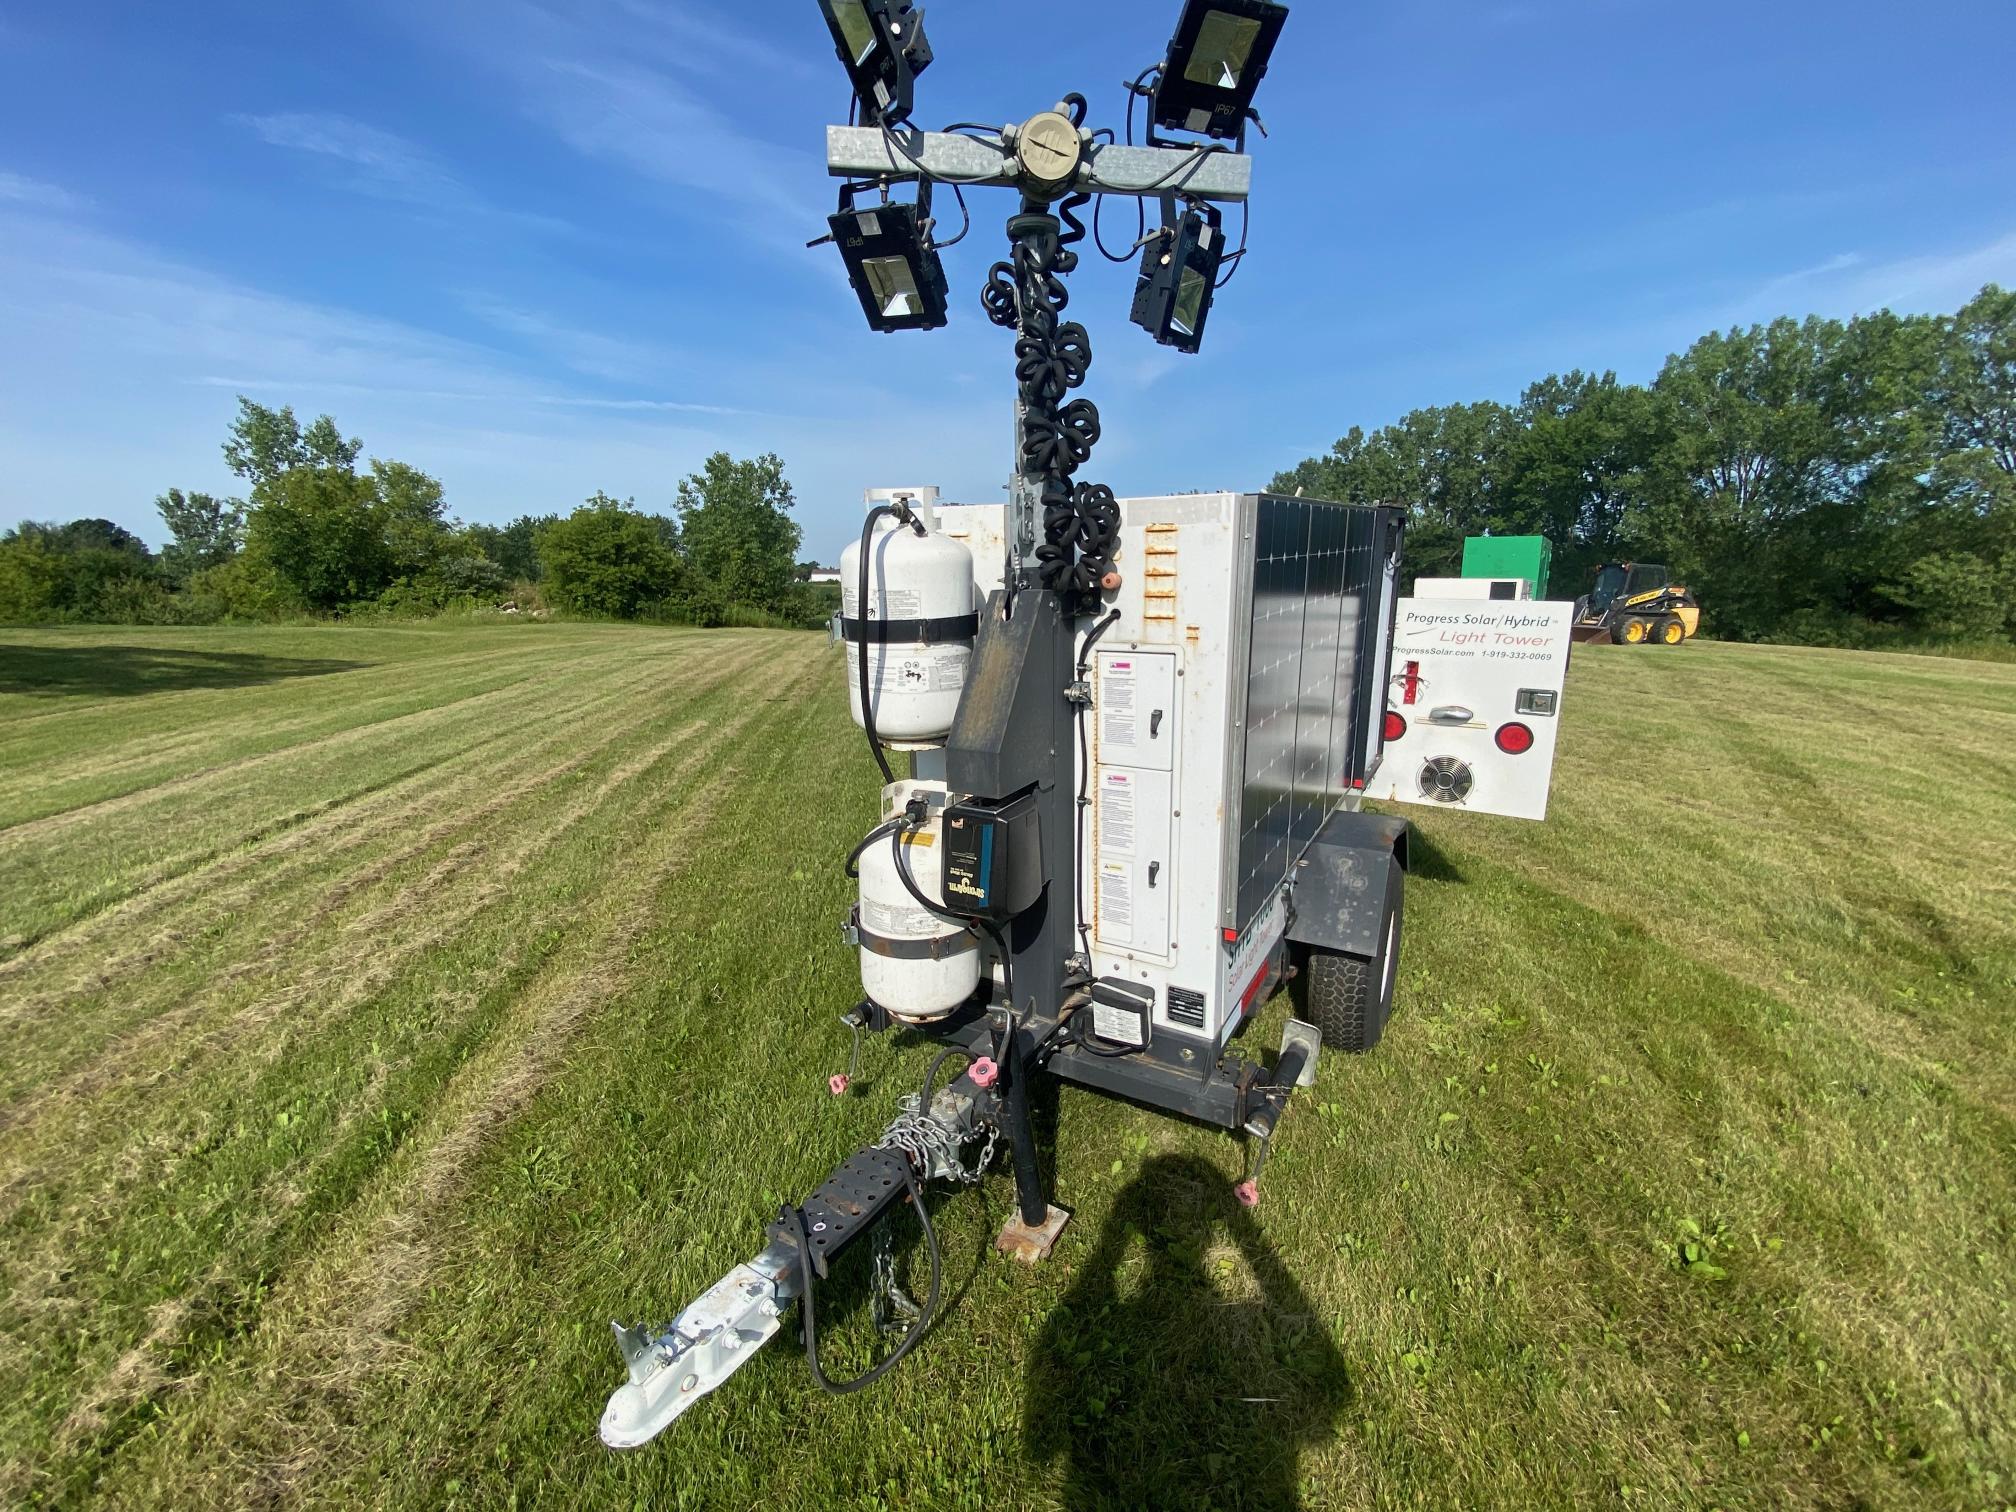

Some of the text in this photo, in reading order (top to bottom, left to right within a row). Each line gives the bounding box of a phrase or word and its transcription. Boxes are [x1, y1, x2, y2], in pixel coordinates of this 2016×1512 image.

[1214, 103, 1236, 115] IP67
[1406, 612, 1459, 625] Progress
[1440, 631, 1554, 646] Light Tower
[1482, 650, 1552, 661] 1-919-332-0069
